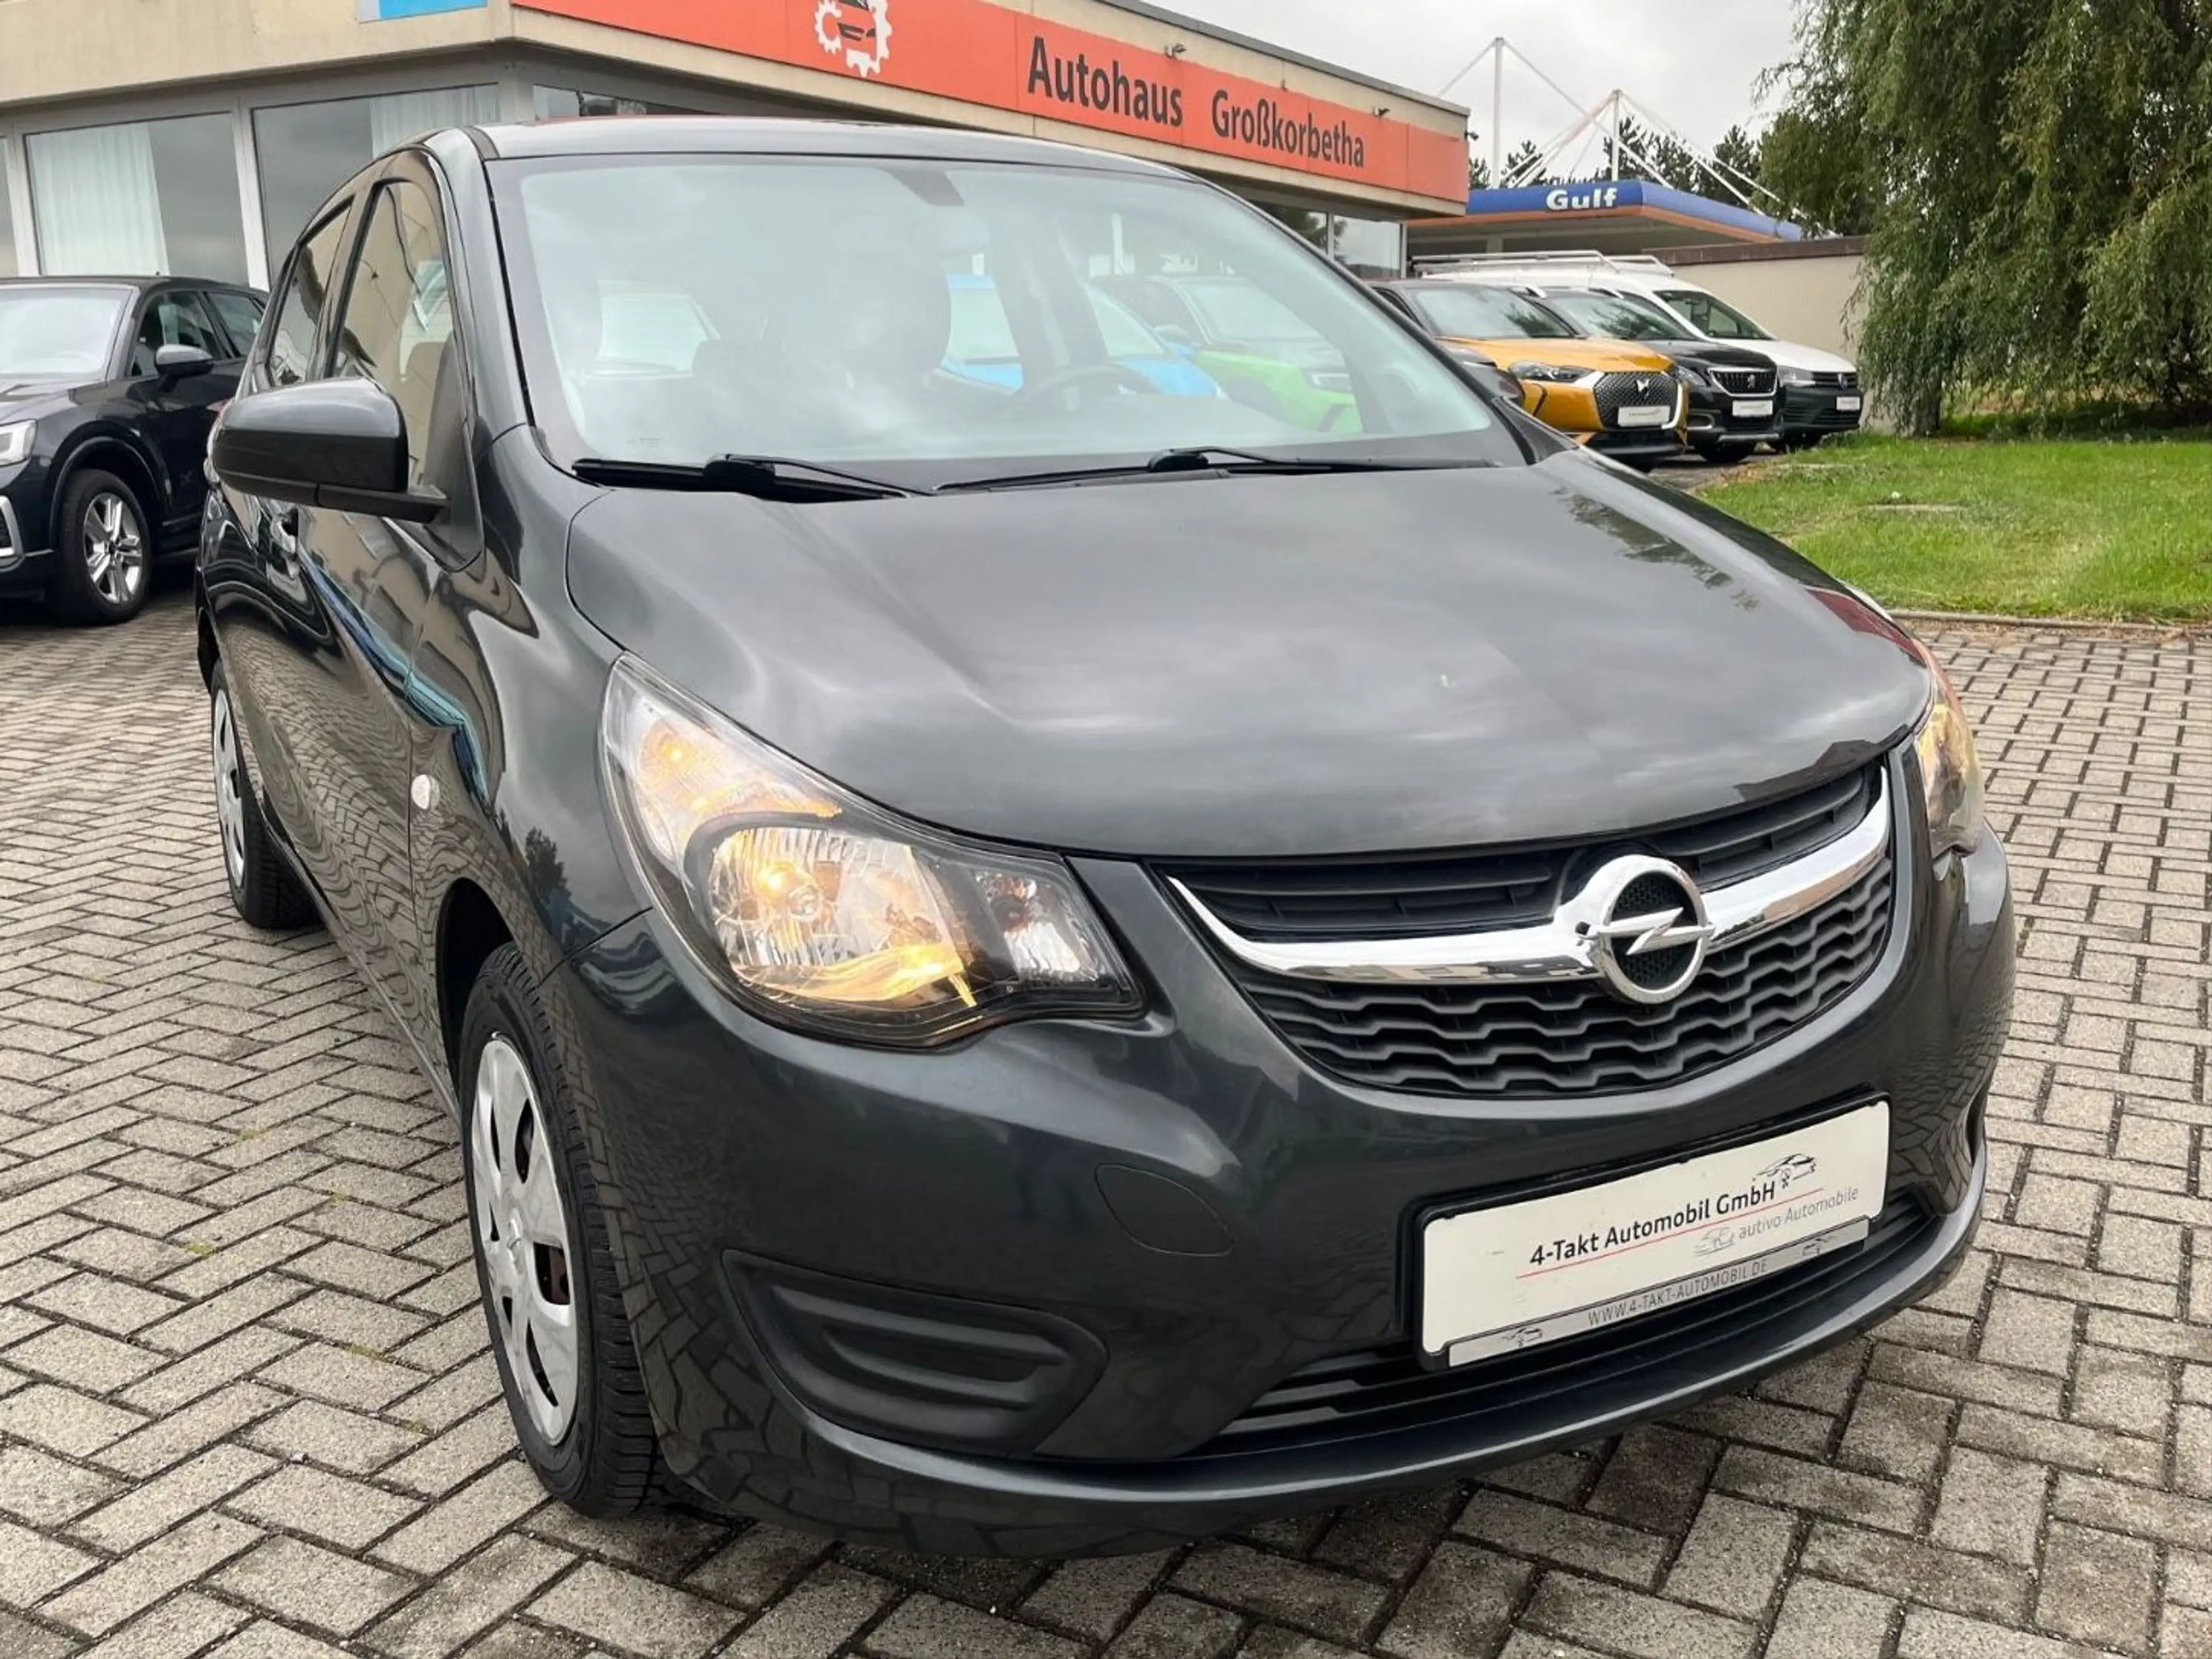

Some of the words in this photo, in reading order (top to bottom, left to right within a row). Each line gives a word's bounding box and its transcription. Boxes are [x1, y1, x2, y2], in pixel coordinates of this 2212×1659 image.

[1028, 36, 1183, 127] Autohaus
[1211, 90, 1364, 168] Großkorbetha
[1546, 187, 1618, 210] Gulf
[1530, 1232, 1599, 1266] 4-Takt
[1605, 1198, 1710, 1248] Automobil
[1717, 1180, 1775, 1215] GmbH
[1738, 1215, 1781, 1239] autivo
[1784, 1186, 1859, 1224] Automobile
[1588, 1259, 1767, 1327] WWW.4-TAKT-AUTOMOBIL.DE
